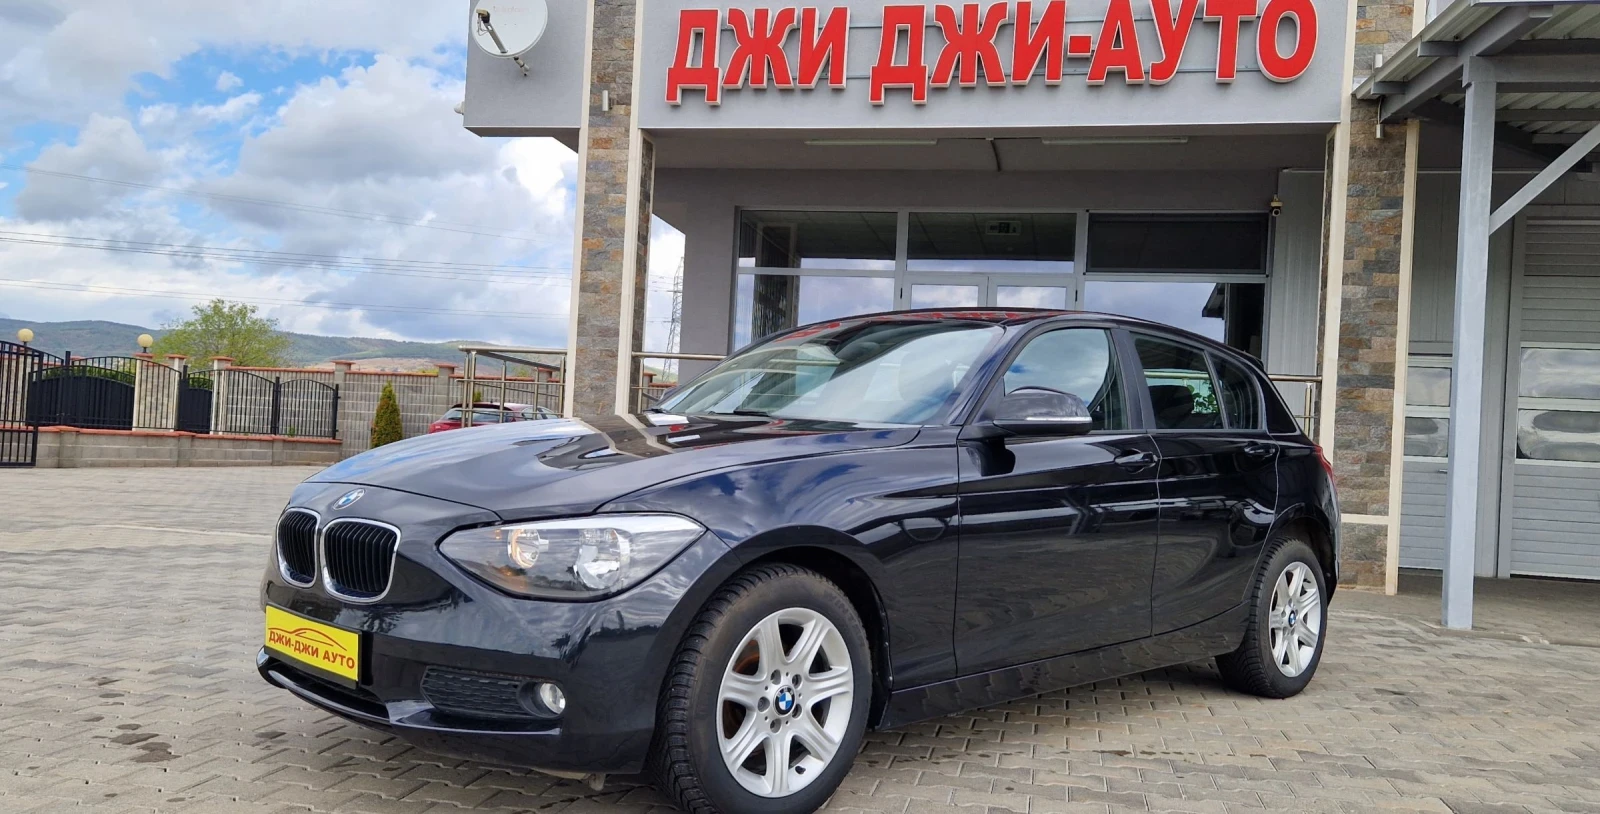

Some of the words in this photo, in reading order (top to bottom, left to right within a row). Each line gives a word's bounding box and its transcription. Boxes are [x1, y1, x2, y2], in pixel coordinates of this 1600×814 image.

[665, 7, 850, 105] ДЖИ
[869, 0, 1319, 106] ДЖИ-АУТО
[269, 631, 319, 658] ДЖИ-ДЖИ
[323, 651, 355, 669] АУТО
